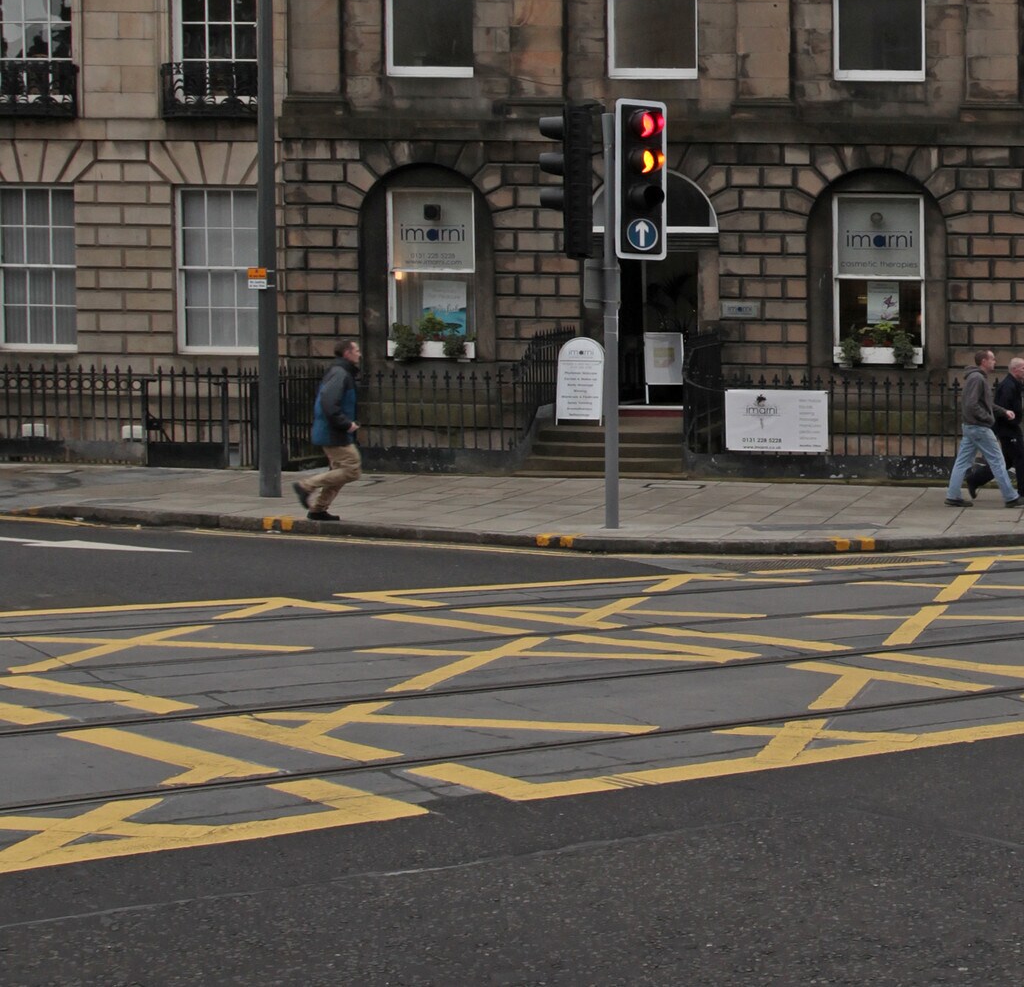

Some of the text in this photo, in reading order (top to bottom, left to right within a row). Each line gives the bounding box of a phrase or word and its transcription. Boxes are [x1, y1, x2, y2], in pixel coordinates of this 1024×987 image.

[400, 224, 465, 241] imarni
[846, 230, 913, 248] imarni
[880, 260, 918, 269] therapies
[746, 406, 778, 414] imarni
